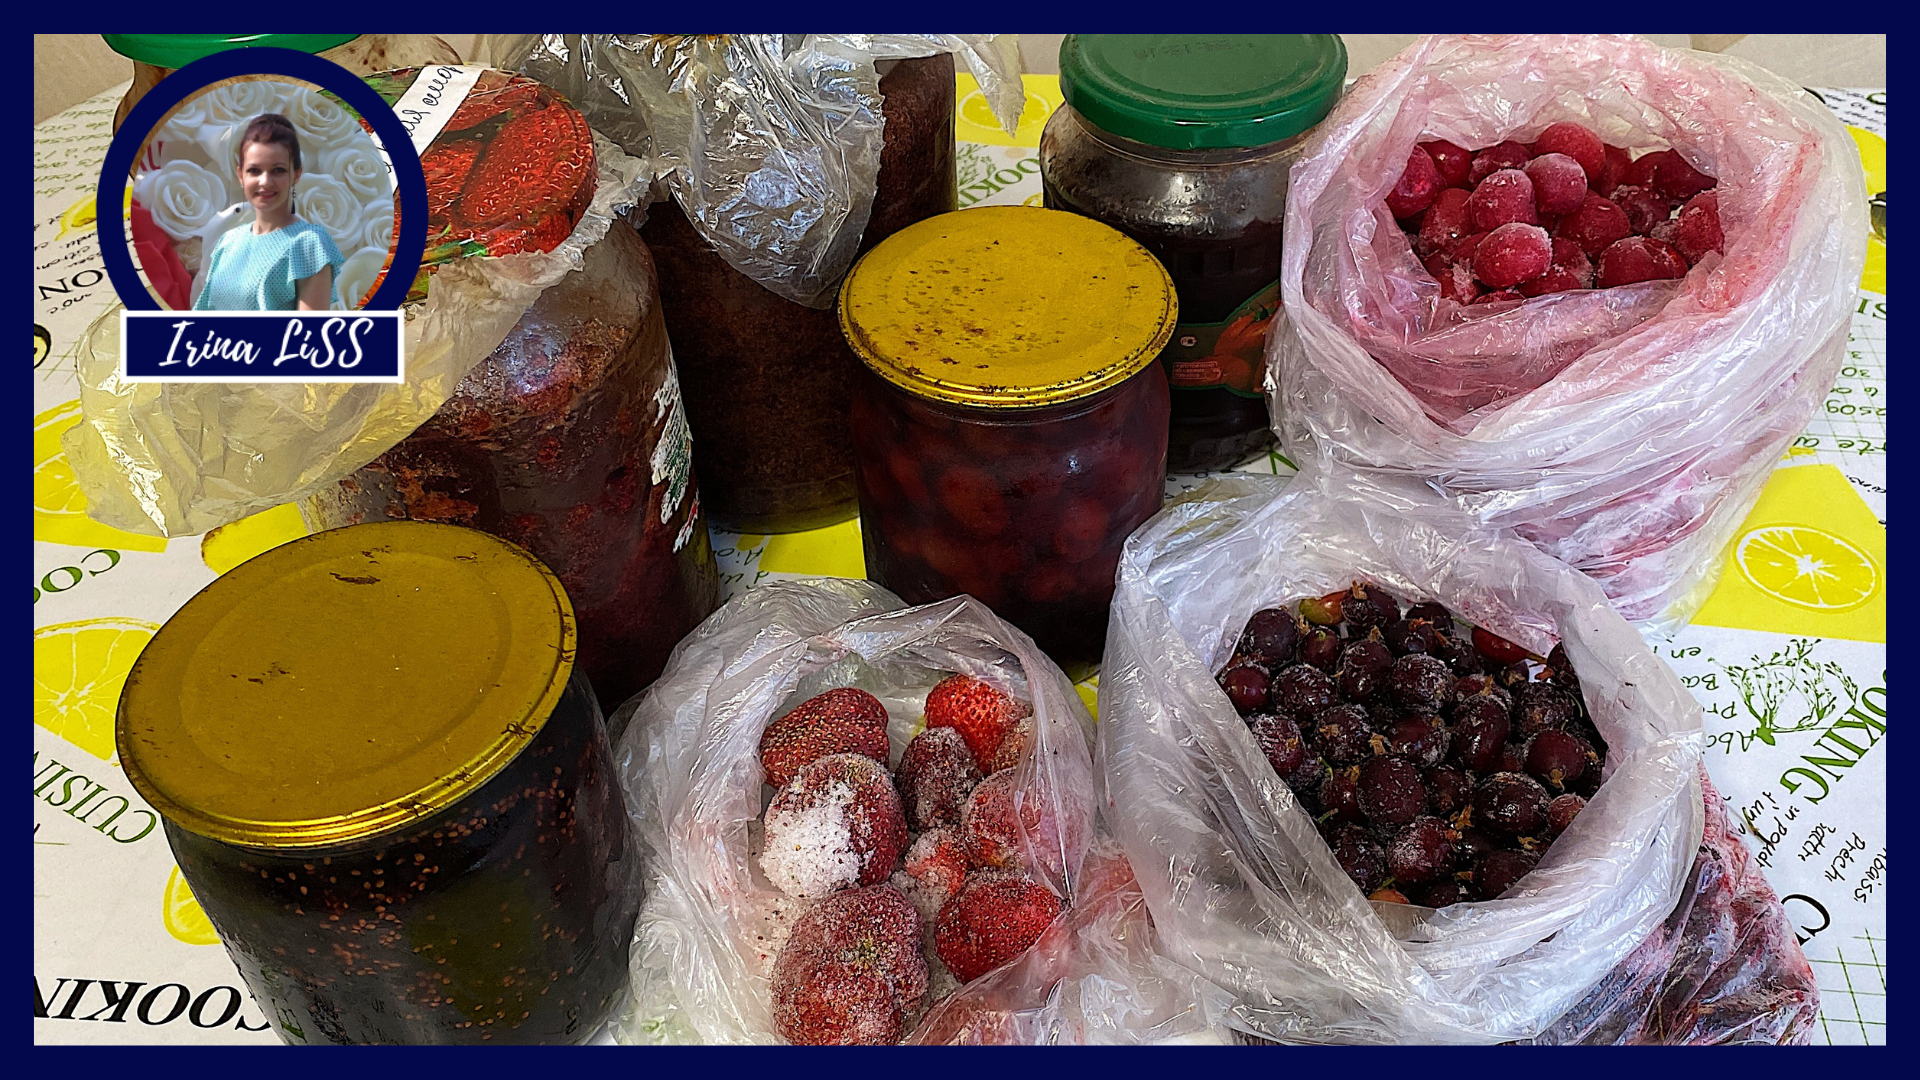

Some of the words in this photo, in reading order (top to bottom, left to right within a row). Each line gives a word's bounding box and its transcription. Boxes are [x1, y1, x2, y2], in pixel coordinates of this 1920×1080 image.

[957, 157, 1041, 207] OOKI
[38, 267, 106, 300] ON
[1681, 674, 1719, 691] Ba
[1702, 701, 1738, 719] Pr
[1779, 686, 1886, 805] OKING
[1824, 832, 1866, 883] Préch
[1853, 847, 1886, 904] baiss
[1781, 893, 1831, 946] C
